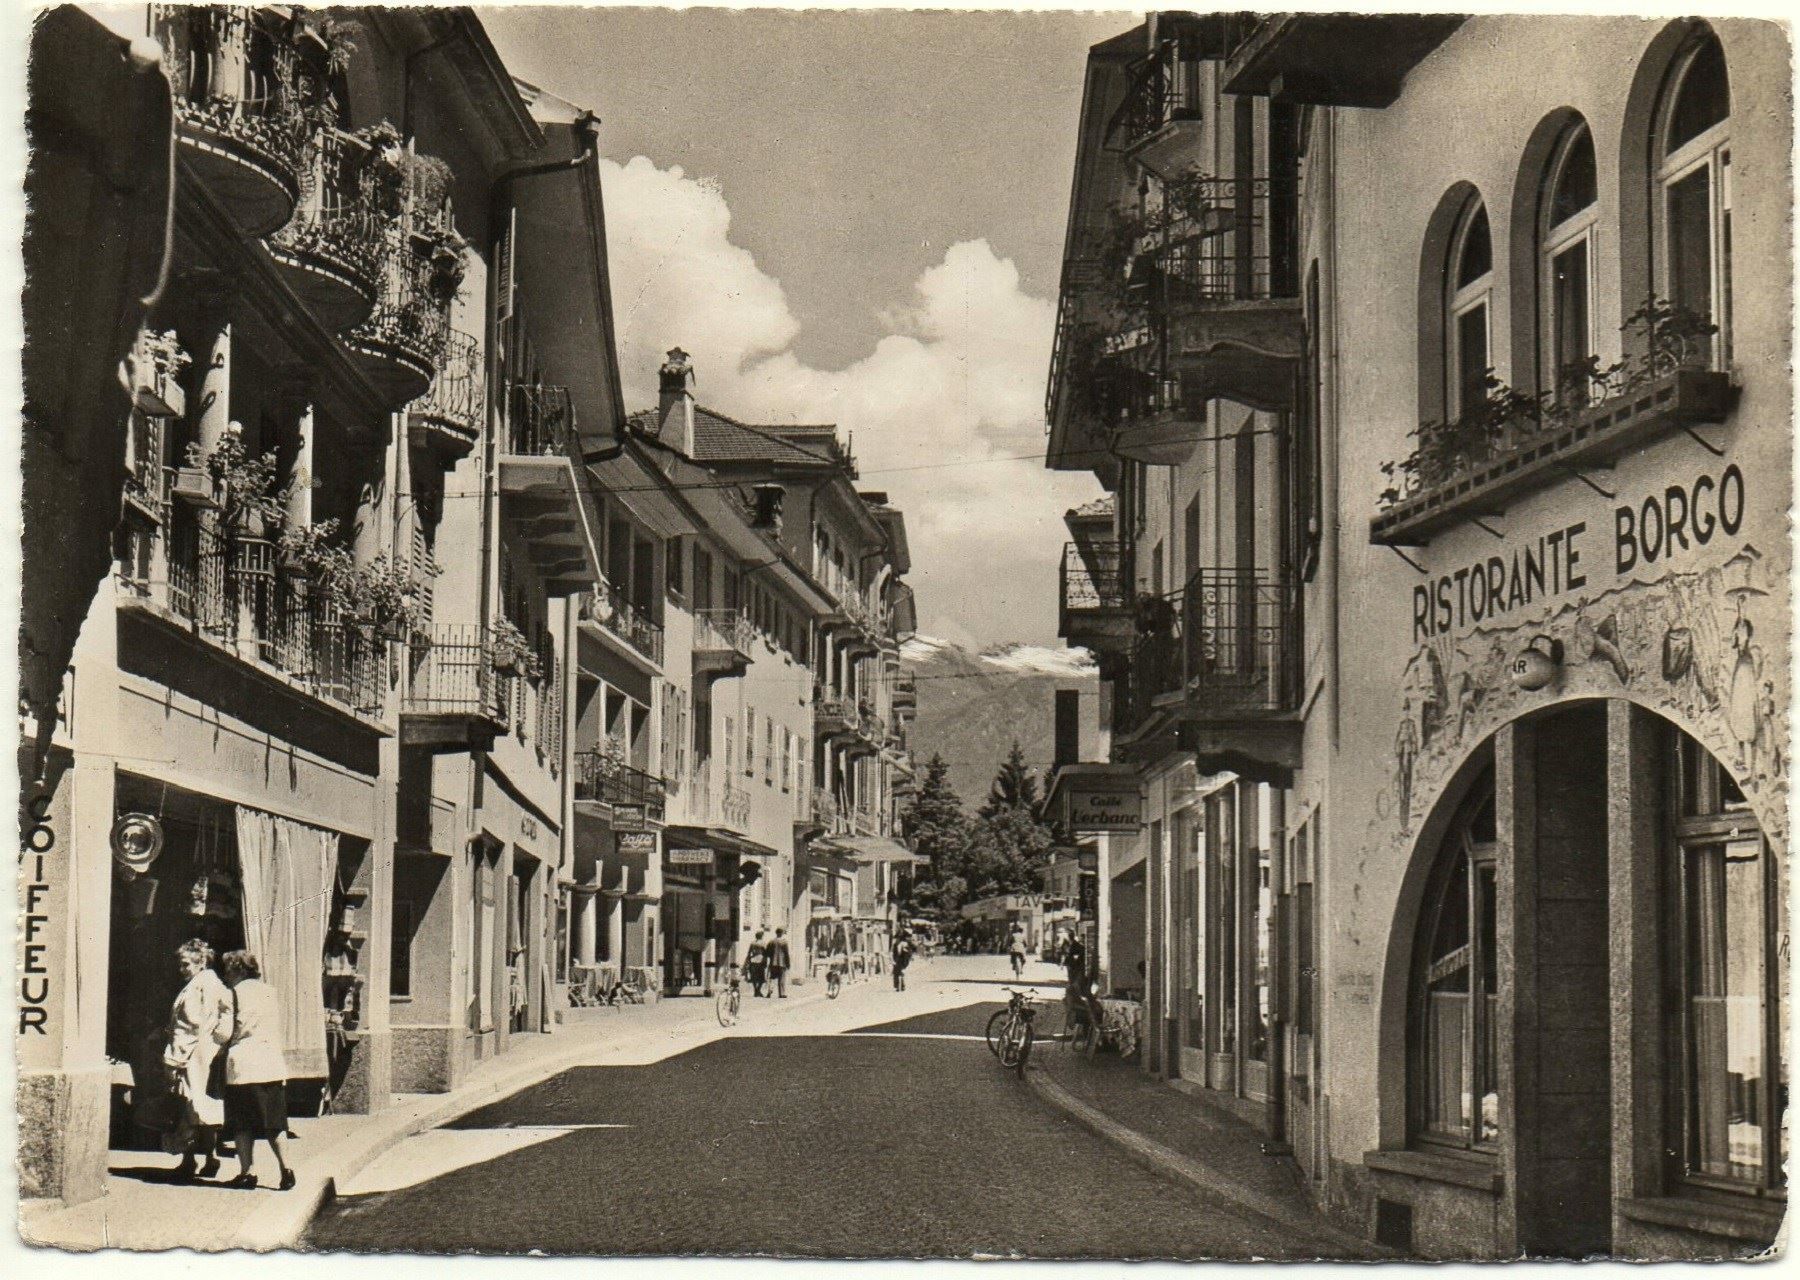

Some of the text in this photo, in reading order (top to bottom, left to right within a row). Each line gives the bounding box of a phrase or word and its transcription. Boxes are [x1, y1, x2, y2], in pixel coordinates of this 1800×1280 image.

[1412, 463, 1745, 644] RISTORANTE BORGO
[19, 795, 55, 1035] COIFFEUR
[1013, 894, 1080, 909] TAVNA
